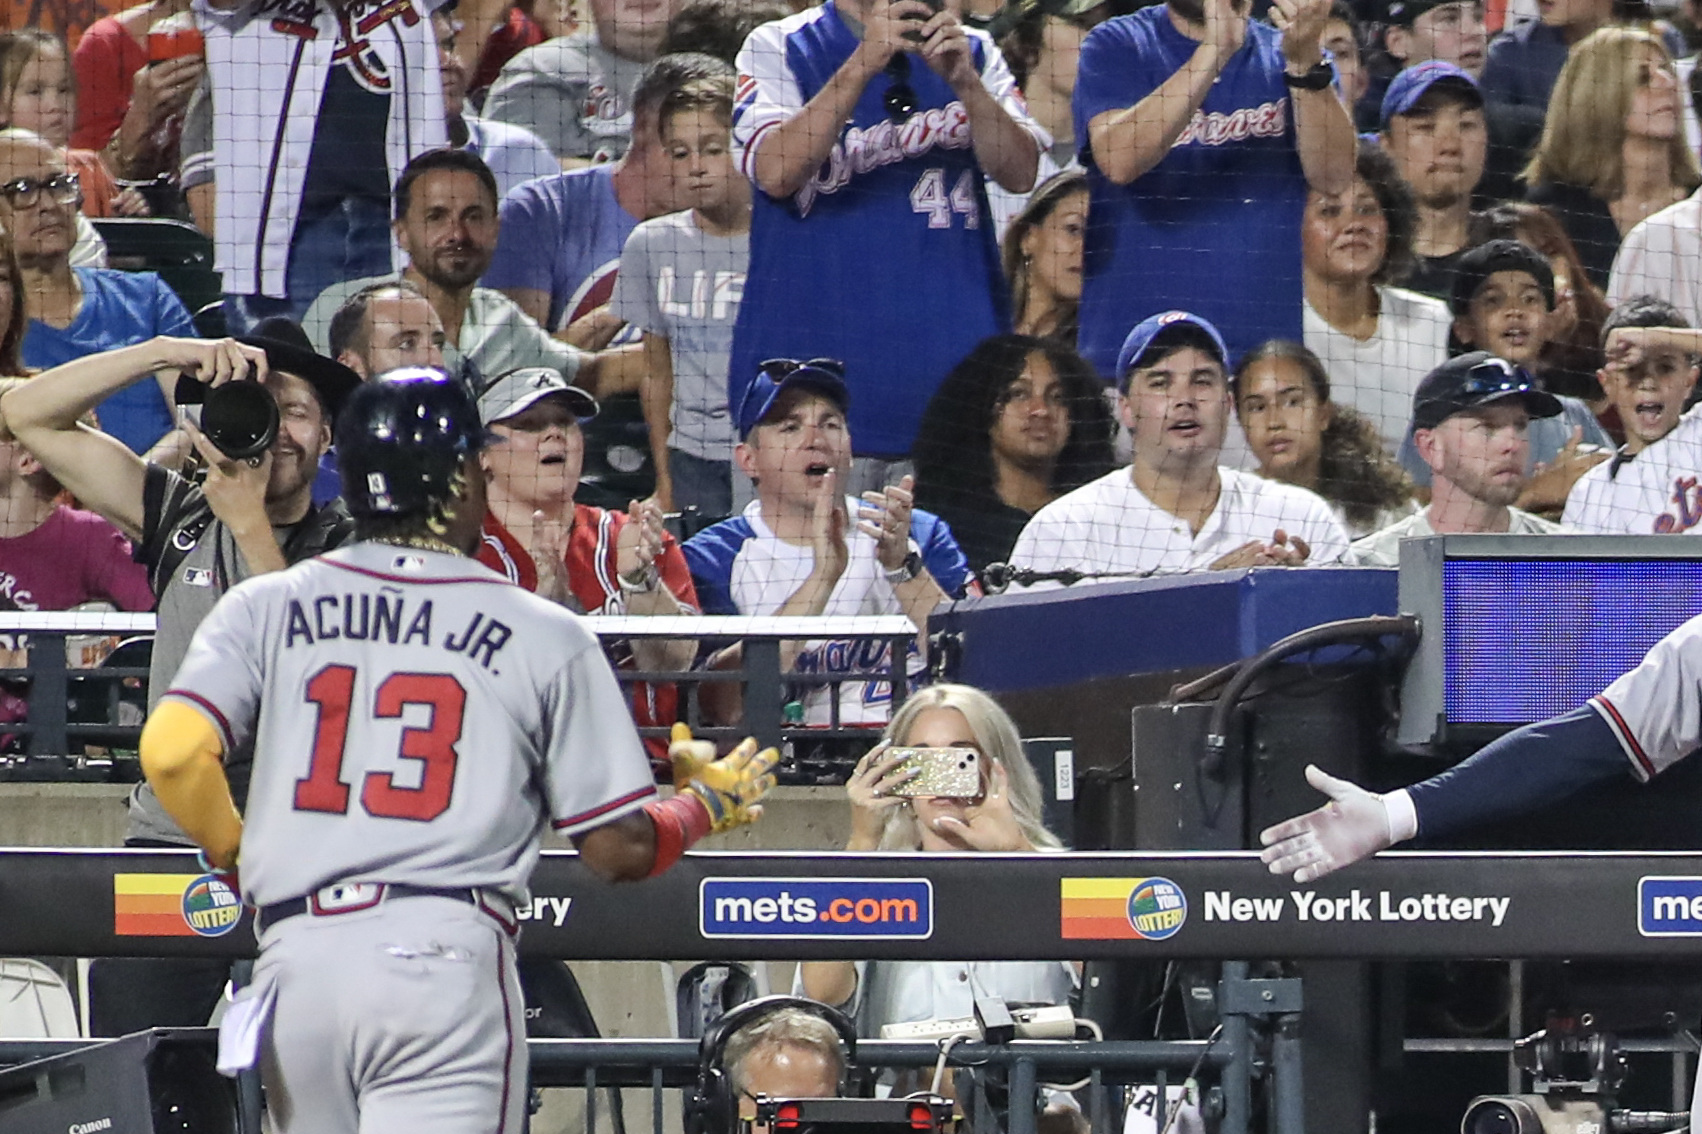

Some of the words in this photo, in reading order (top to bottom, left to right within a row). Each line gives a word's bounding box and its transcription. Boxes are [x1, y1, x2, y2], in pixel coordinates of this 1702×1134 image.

[909, 167, 979, 229] 44
[657, 264, 747, 319] LIF
[286, 585, 433, 648] ACUÑA
[444, 611, 511, 676] JR.
[292, 662, 467, 823] 13
[715, 892, 918, 924] mets.com
[1133, 908, 1184, 932] LOTTERY
[1204, 891, 1284, 921] New
[1290, 890, 1372, 921] York
[1380, 891, 1511, 927] Lottery
